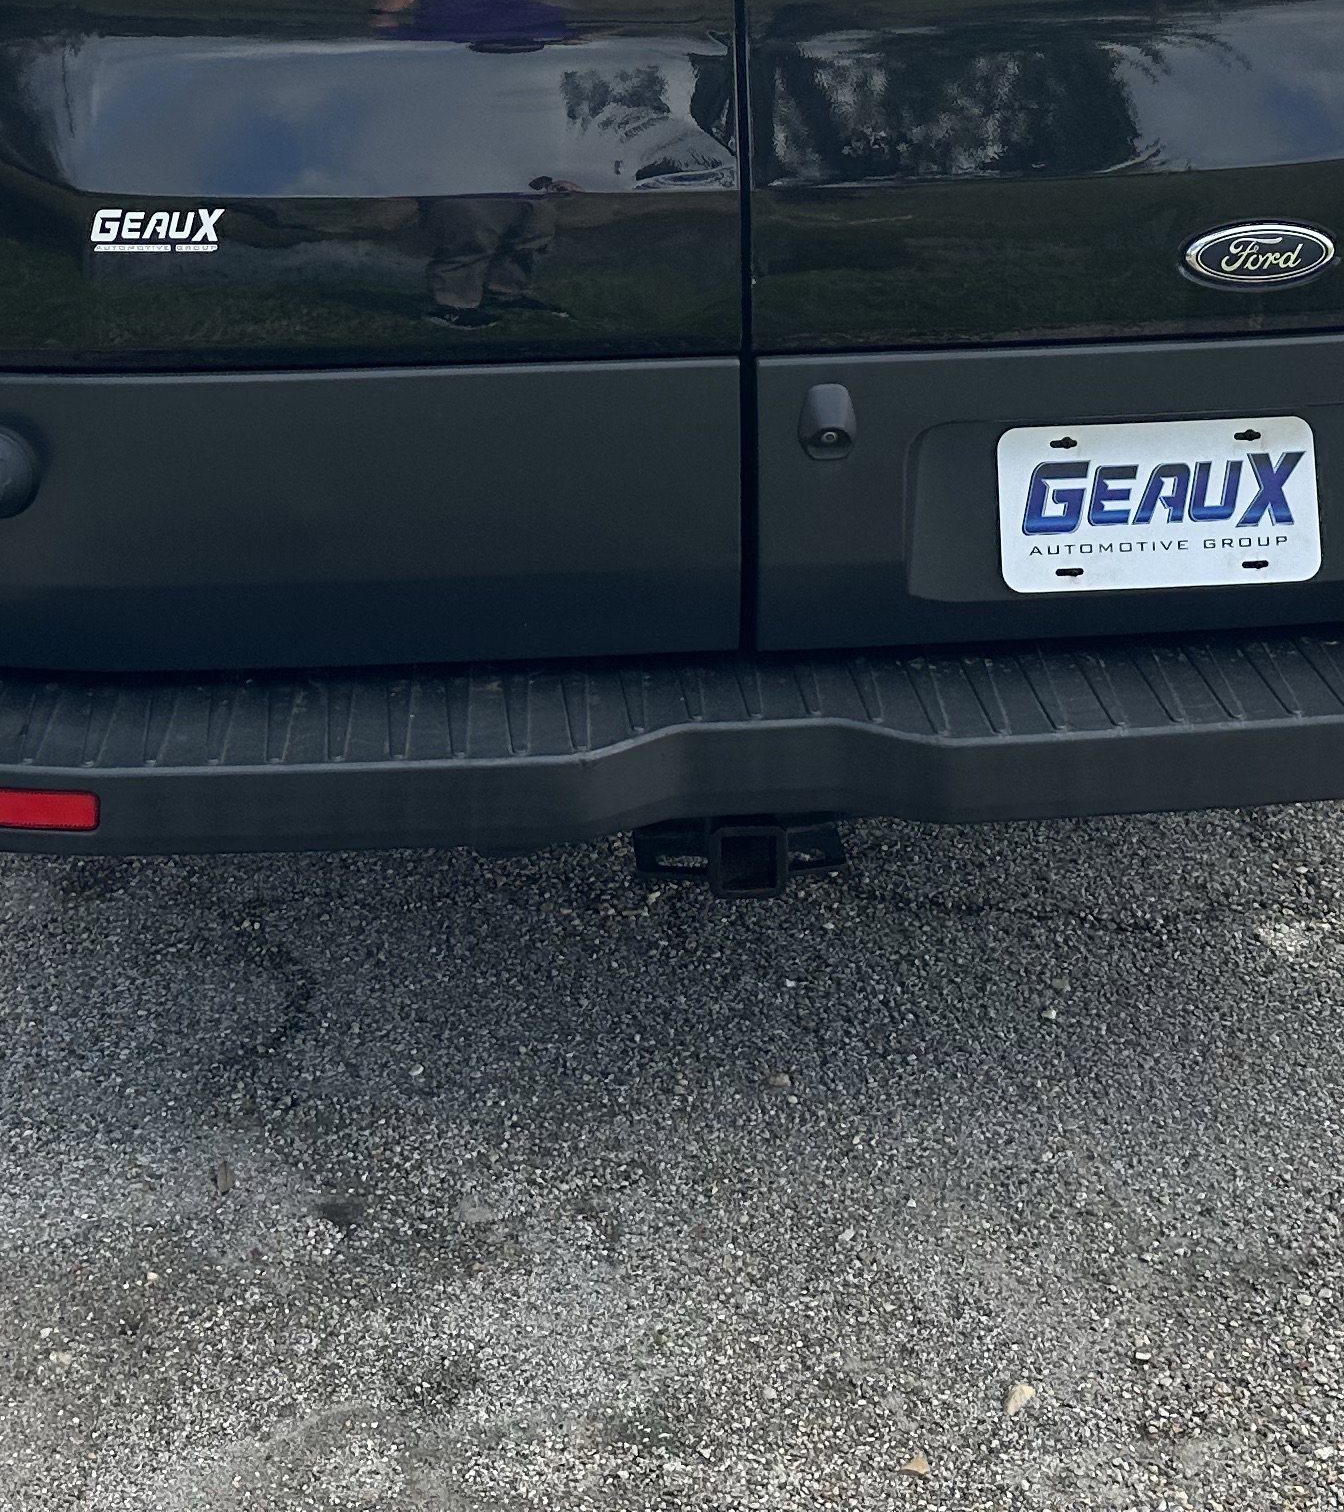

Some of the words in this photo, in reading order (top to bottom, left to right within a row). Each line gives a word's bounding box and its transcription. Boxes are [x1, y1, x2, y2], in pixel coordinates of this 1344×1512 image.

[90, 208, 225, 242] GEAUX
[1220, 236, 1304, 272] Ford
[1021, 450, 1306, 537] GEAUX
[1029, 539, 1189, 556] AUTOMOTIVE
[1203, 535, 1289, 549] GROUP
